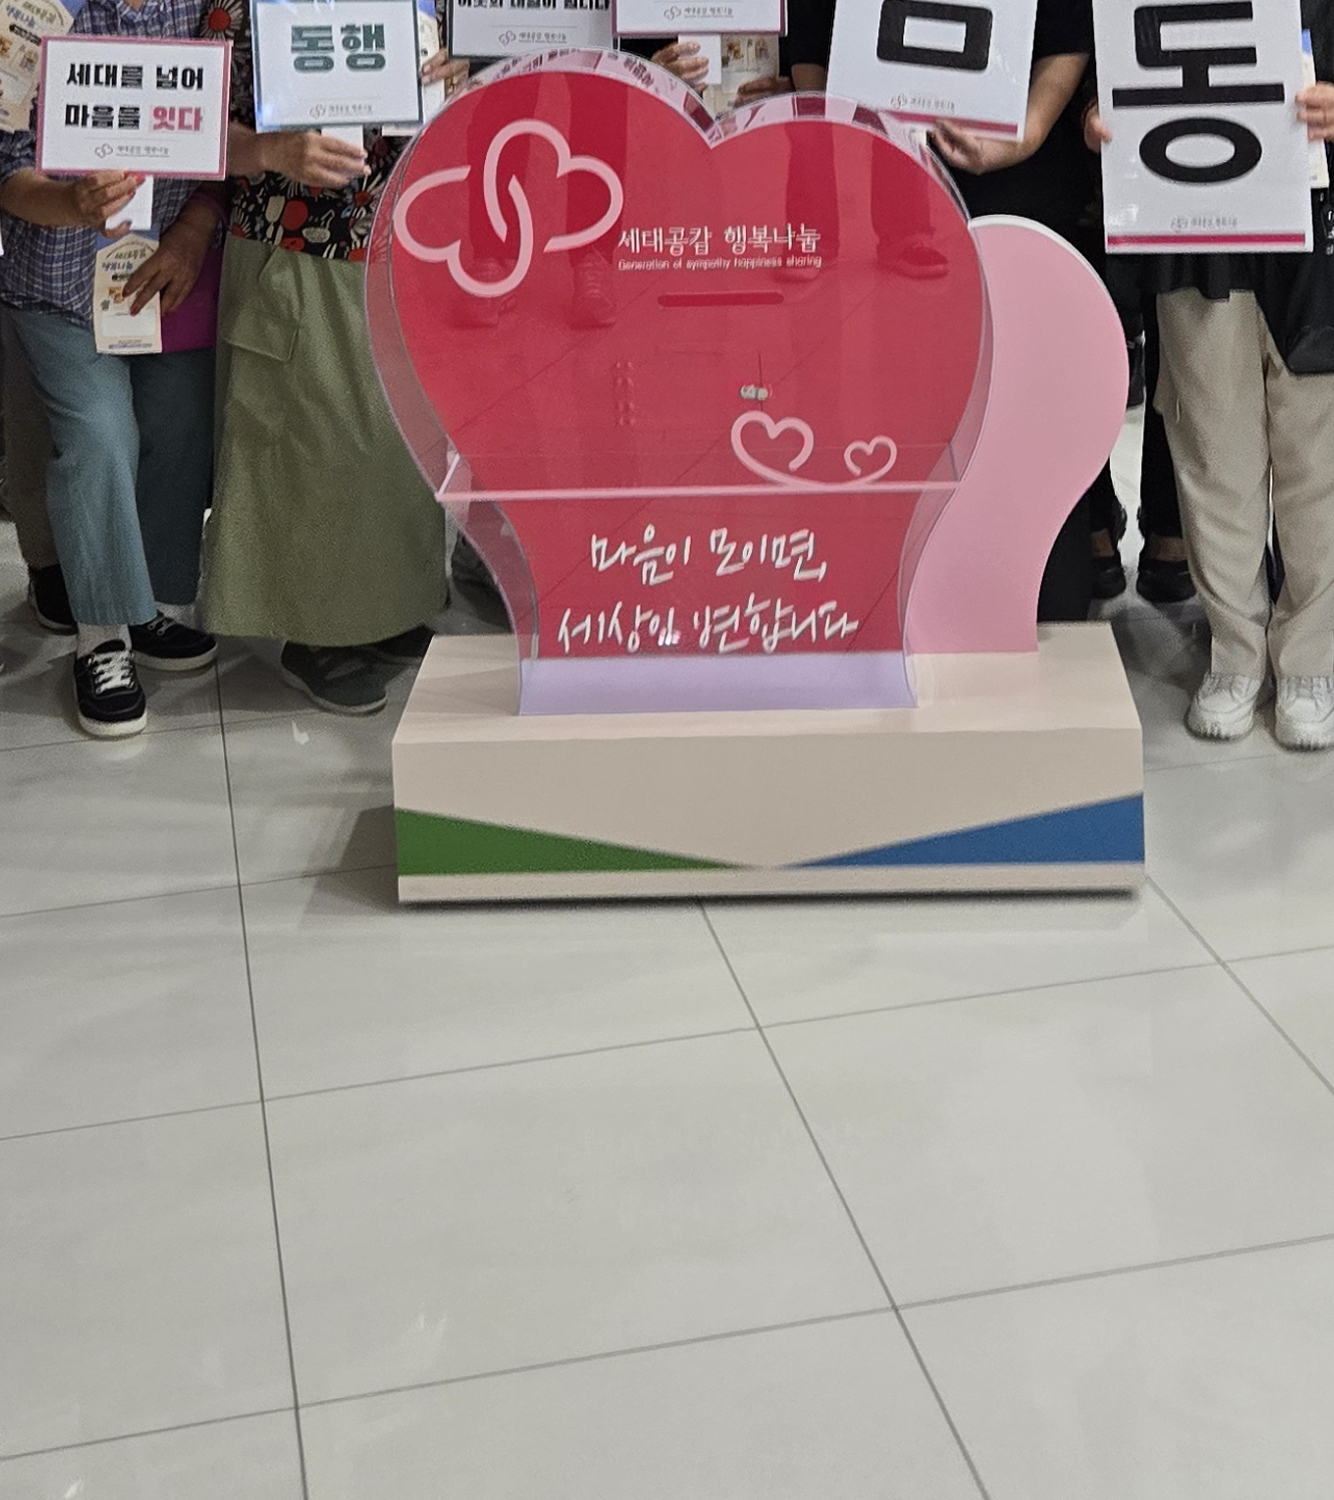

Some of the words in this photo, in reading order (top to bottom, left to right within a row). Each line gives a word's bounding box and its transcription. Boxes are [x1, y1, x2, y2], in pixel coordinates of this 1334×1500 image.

[291, 24, 387, 73] 동행
[66, 63, 144, 90] 세대를
[156, 65, 204, 91] 넘어
[1112, 0, 1286, 185] 동
[152, 106, 204, 132] 잇다
[618, 225, 713, 257] 세대공감
[723, 222, 822, 256] 행복나눔
[618, 258, 670, 271] Generation
[672, 257, 683, 270] of
[686, 256, 731, 271] sympathy
[733, 256, 782, 270] happiness
[786, 254, 823, 269] sharing
[591, 523, 692, 586] 마음이
[693, 592, 860, 655] 변합니다
